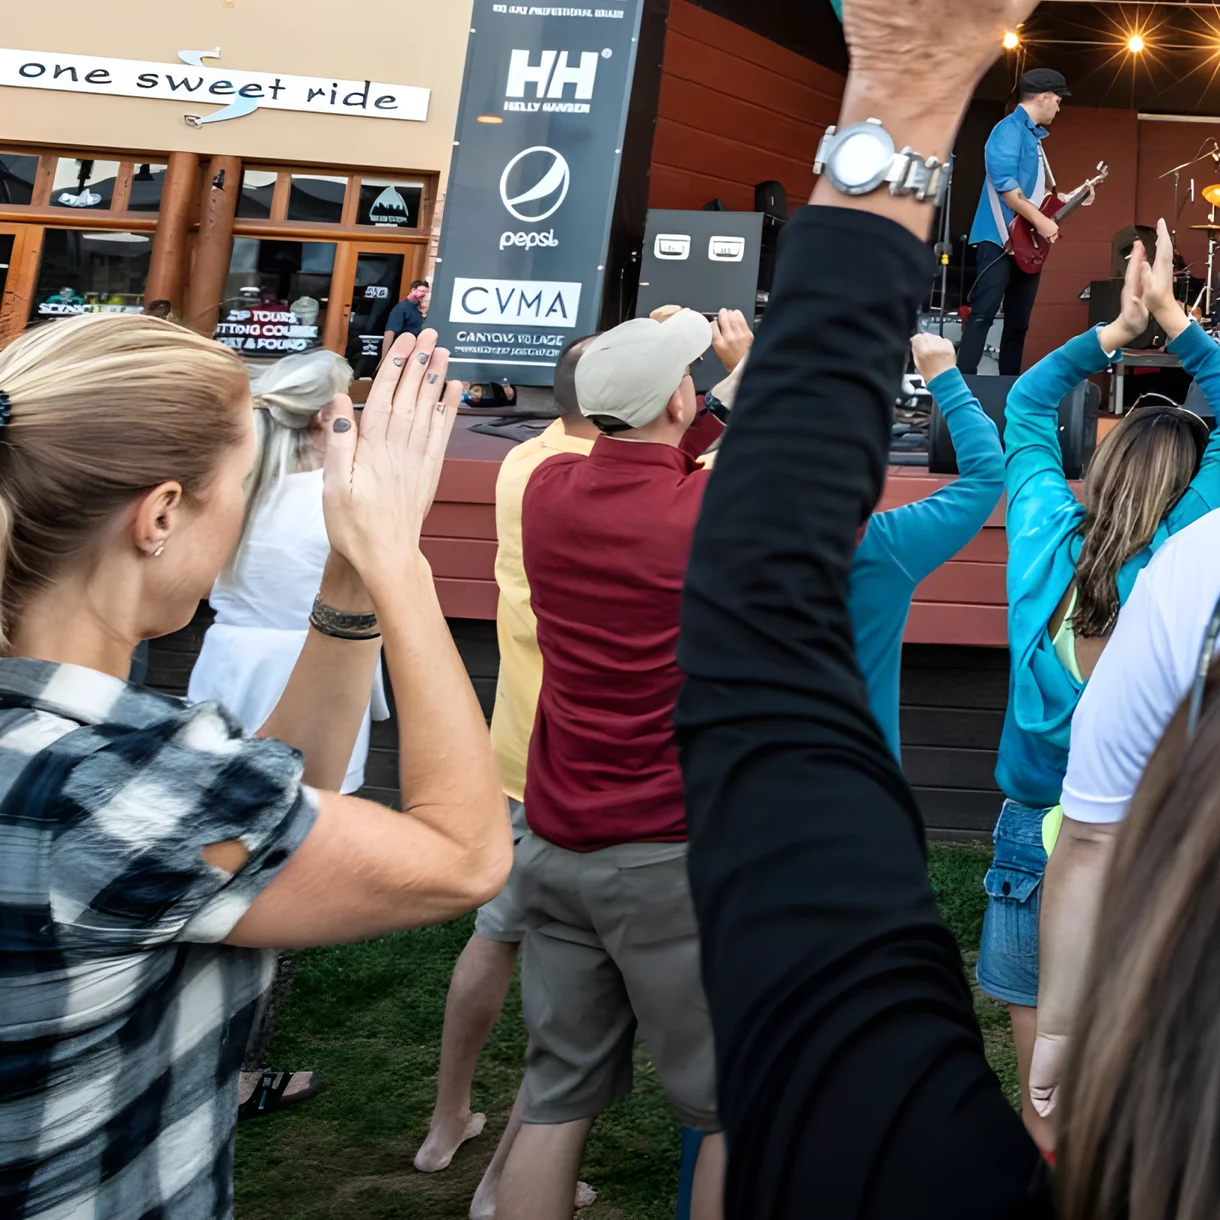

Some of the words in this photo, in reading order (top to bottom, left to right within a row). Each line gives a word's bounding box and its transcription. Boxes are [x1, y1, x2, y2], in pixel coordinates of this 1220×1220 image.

[18, 61, 112, 85] one
[136, 72, 286, 100] sweet
[307, 80, 399, 110] ride
[499, 228, 559, 250] pepsi
[461, 286, 568, 319] CVMA
